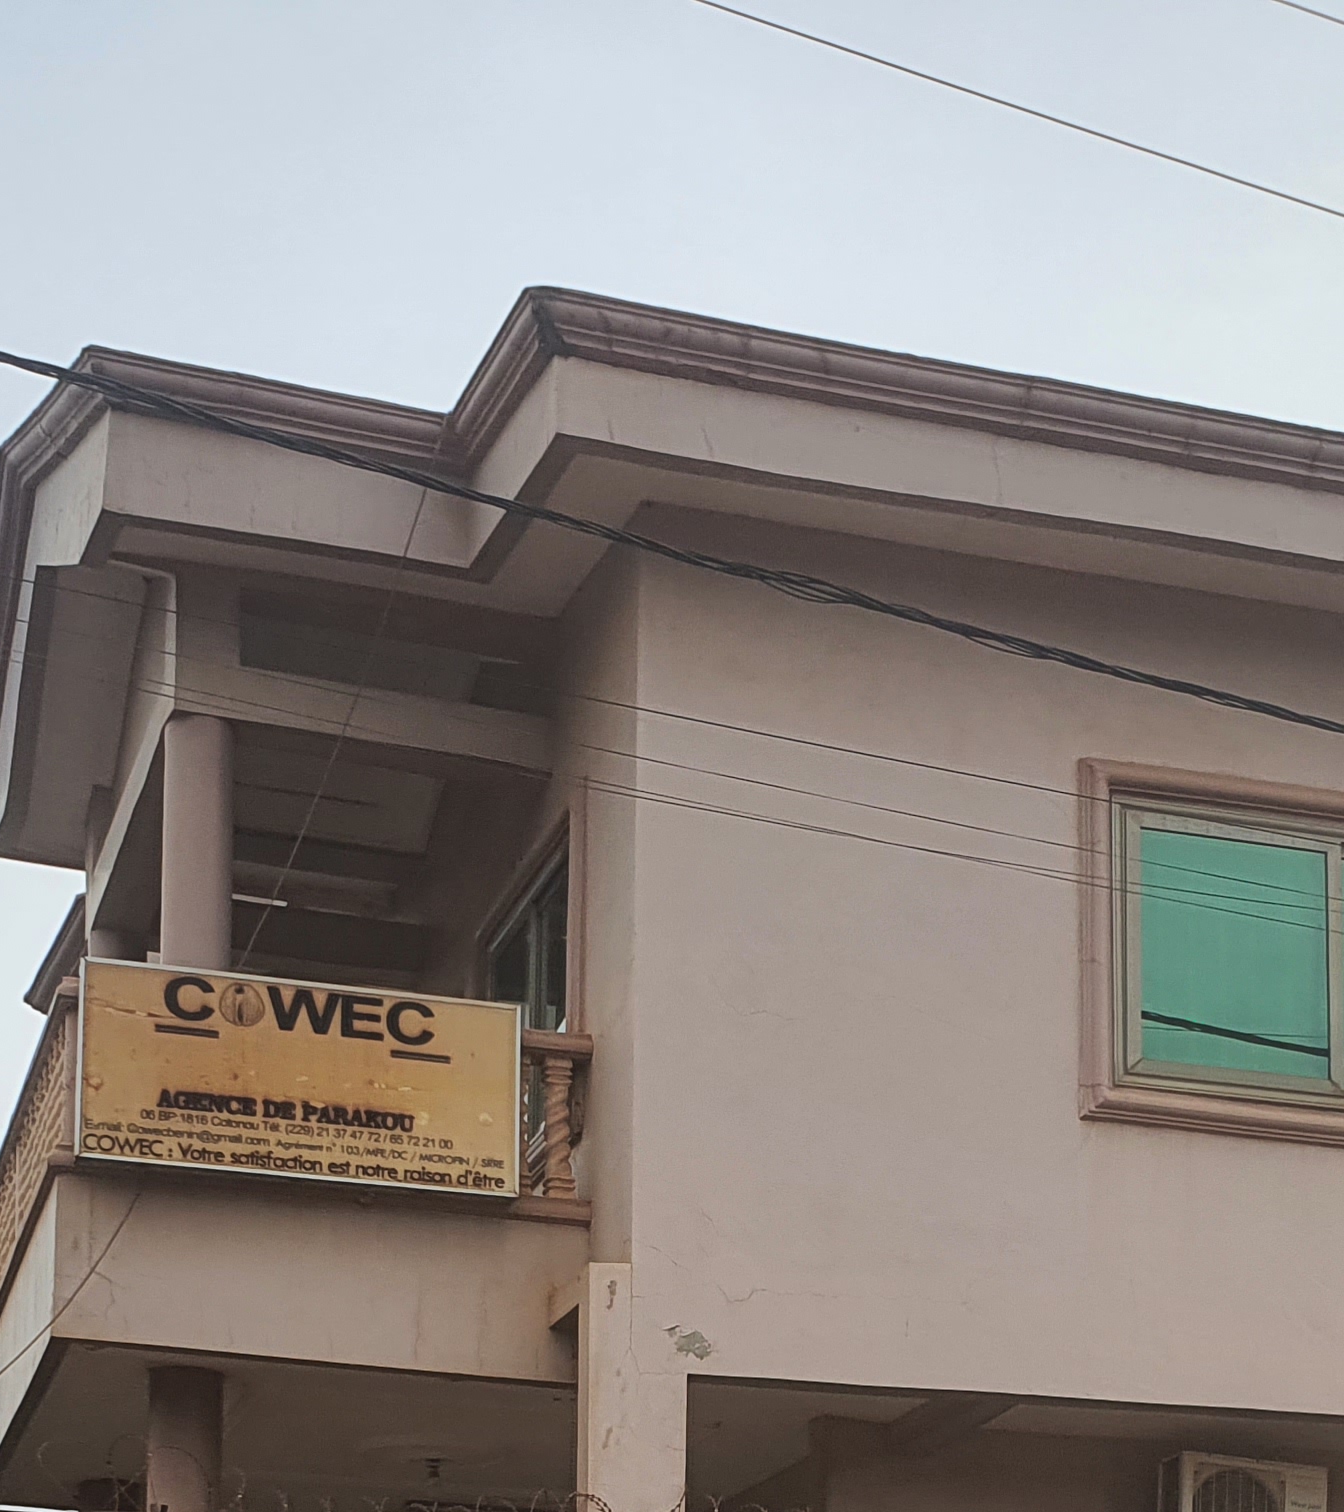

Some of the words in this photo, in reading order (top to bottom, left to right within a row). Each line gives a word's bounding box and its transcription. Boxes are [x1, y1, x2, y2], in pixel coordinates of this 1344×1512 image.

[157, 1088, 258, 1117] AGENCE
[262, 1098, 296, 1120] DE
[301, 1101, 415, 1133] PARAKOU
[211, 1116, 259, 1131] Cotonou
[285, 1123, 314, 1138] (229)
[316, 1126, 329, 1137] 21
[332, 1128, 347, 1139] 37
[367, 1132, 381, 1143] 72
[406, 1136, 420, 1147] 72
[422, 1137, 436, 1148] 21
[438, 1138, 453, 1150] 00
[83, 1133, 164, 1157] COWEC
[177, 1142, 225, 1163] Votre
[230, 1149, 323, 1172] satisfaction
[327, 1160, 350, 1174] est
[355, 1162, 398, 1180] notre
[404, 1166, 453, 1185] raison
[457, 1170, 505, 1189] d'être
